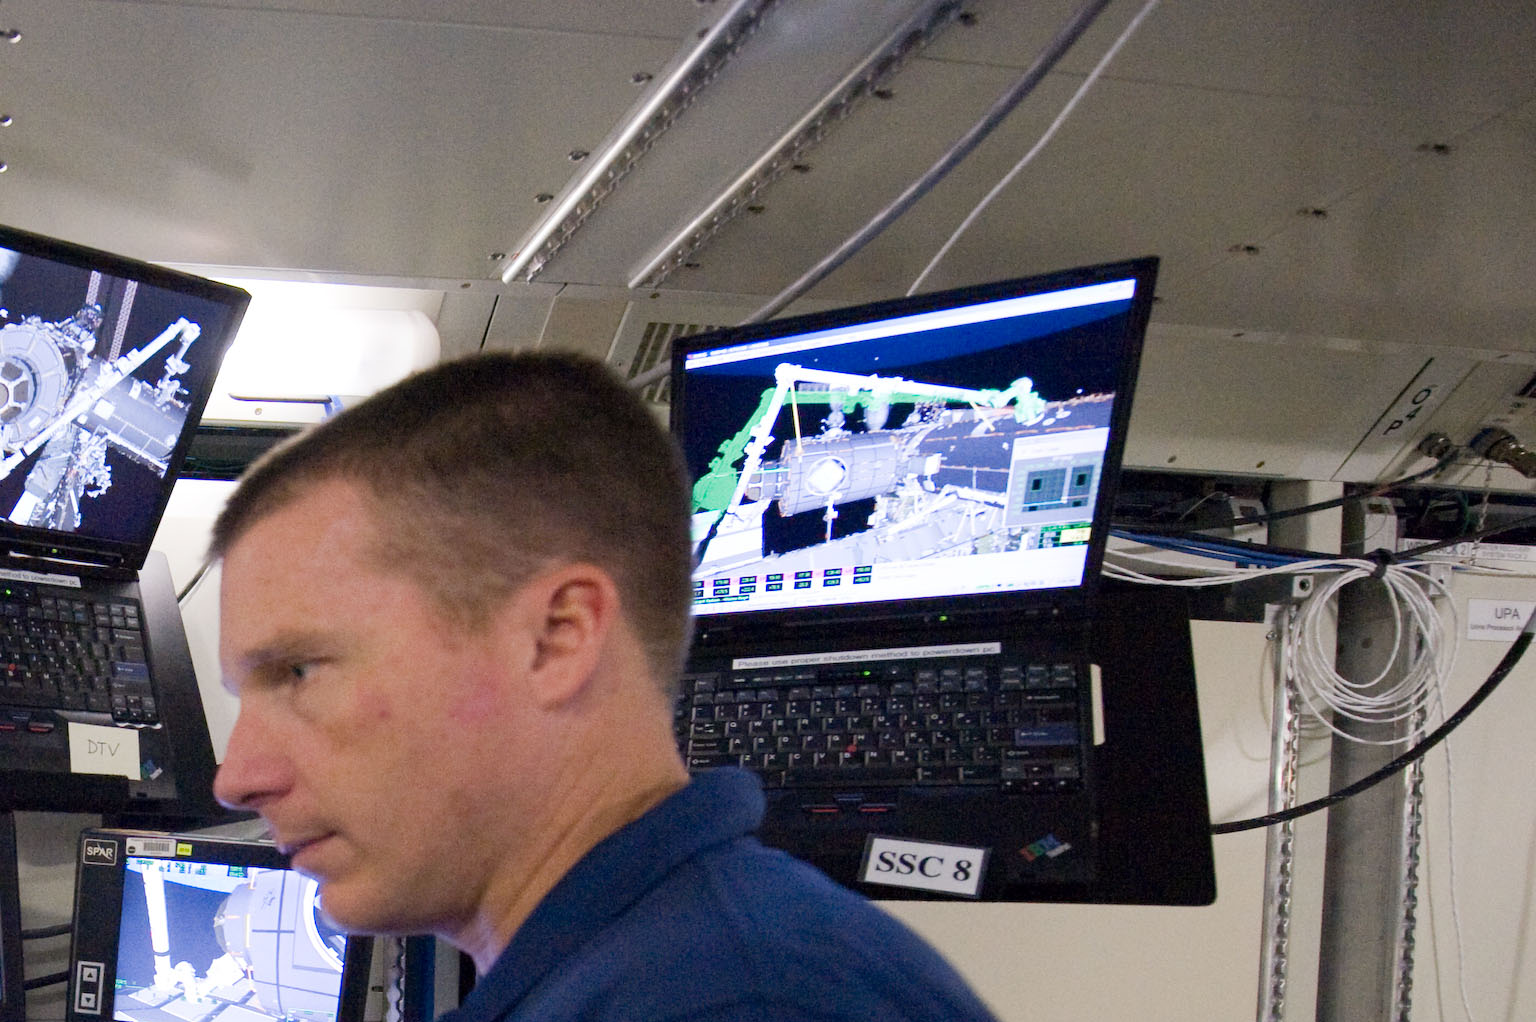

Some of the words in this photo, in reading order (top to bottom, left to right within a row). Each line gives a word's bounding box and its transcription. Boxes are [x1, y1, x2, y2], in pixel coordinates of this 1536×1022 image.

[1494, 607, 1520, 621] UPA
[922, 647, 979, 657] powerdown
[87, 739, 120, 757] DTV
[86, 845, 114, 860] SPAR
[875, 851, 944, 878] SSC
[953, 860, 972, 881] 8
